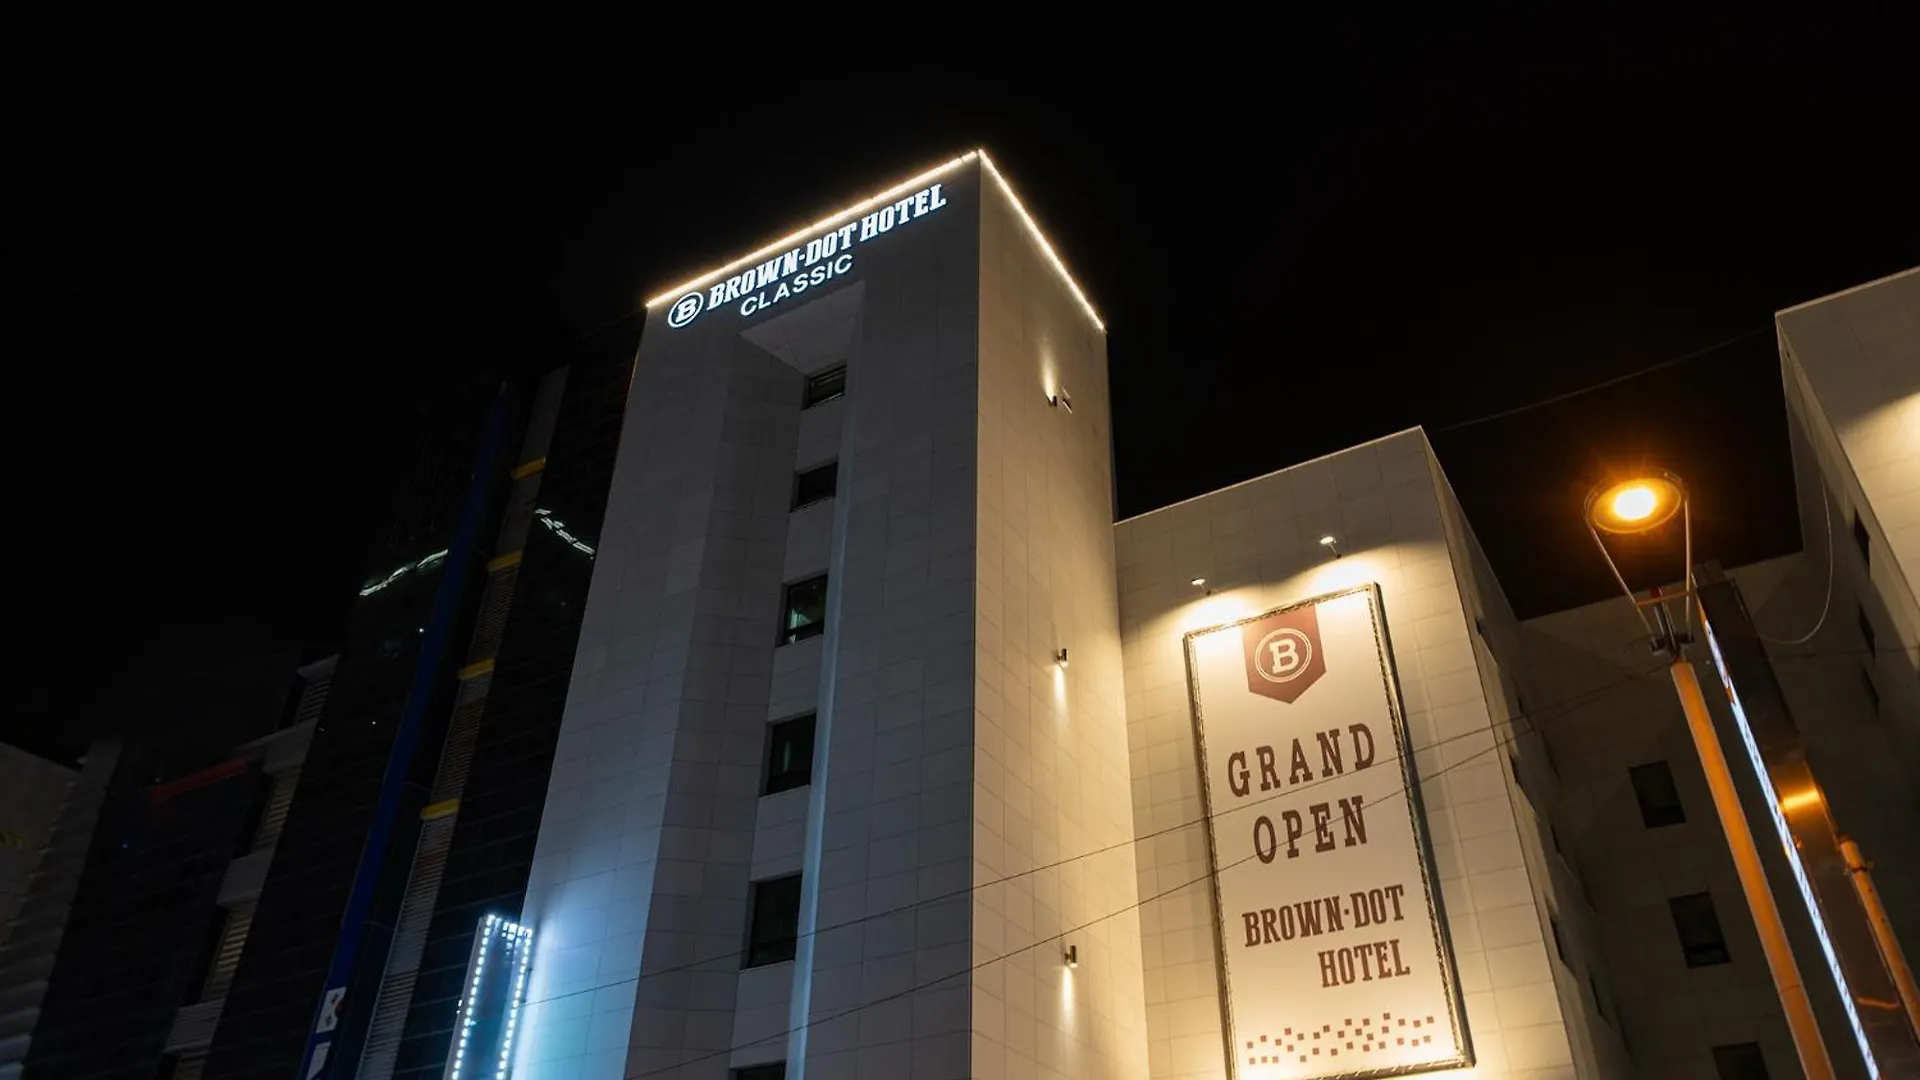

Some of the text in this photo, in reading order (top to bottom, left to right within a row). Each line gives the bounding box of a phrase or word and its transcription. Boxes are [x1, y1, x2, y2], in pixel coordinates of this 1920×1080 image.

[859, 183, 947, 242] HOTEL
[740, 253, 853, 316] CLASSIC
[1269, 638, 1299, 674] B
[1227, 723, 1375, 797] GRAND
[1253, 795, 1367, 864] OPEN
[1318, 938, 1411, 989] HOTEL
